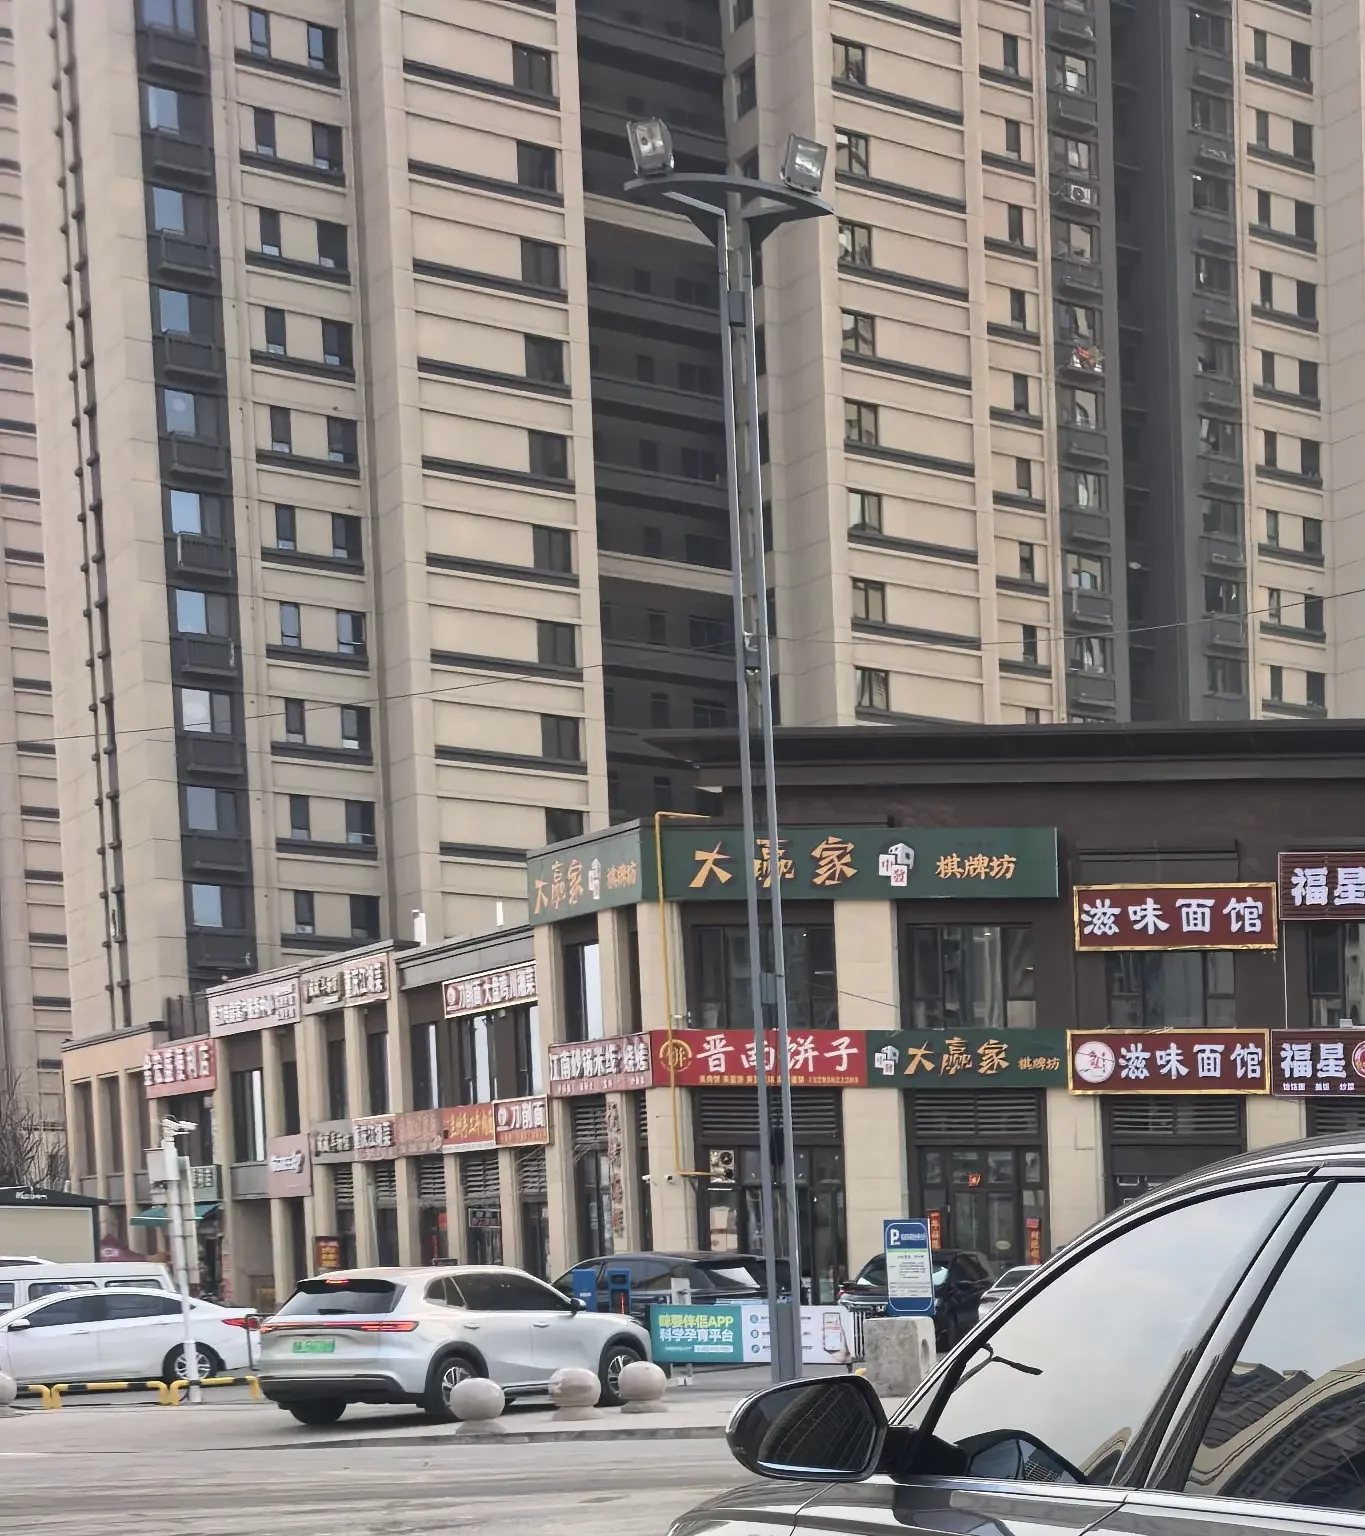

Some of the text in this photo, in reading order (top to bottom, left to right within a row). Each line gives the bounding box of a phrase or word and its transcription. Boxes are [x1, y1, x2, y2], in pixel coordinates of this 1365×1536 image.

[689, 836, 858, 888] 大赢家
[936, 854, 1017, 881] 棋牌坊
[1080, 897, 1263, 935] 滋味面馆
[904, 1037, 1010, 1076] 大赢家
[1118, 1042, 1262, 1079] 滋味面馆
